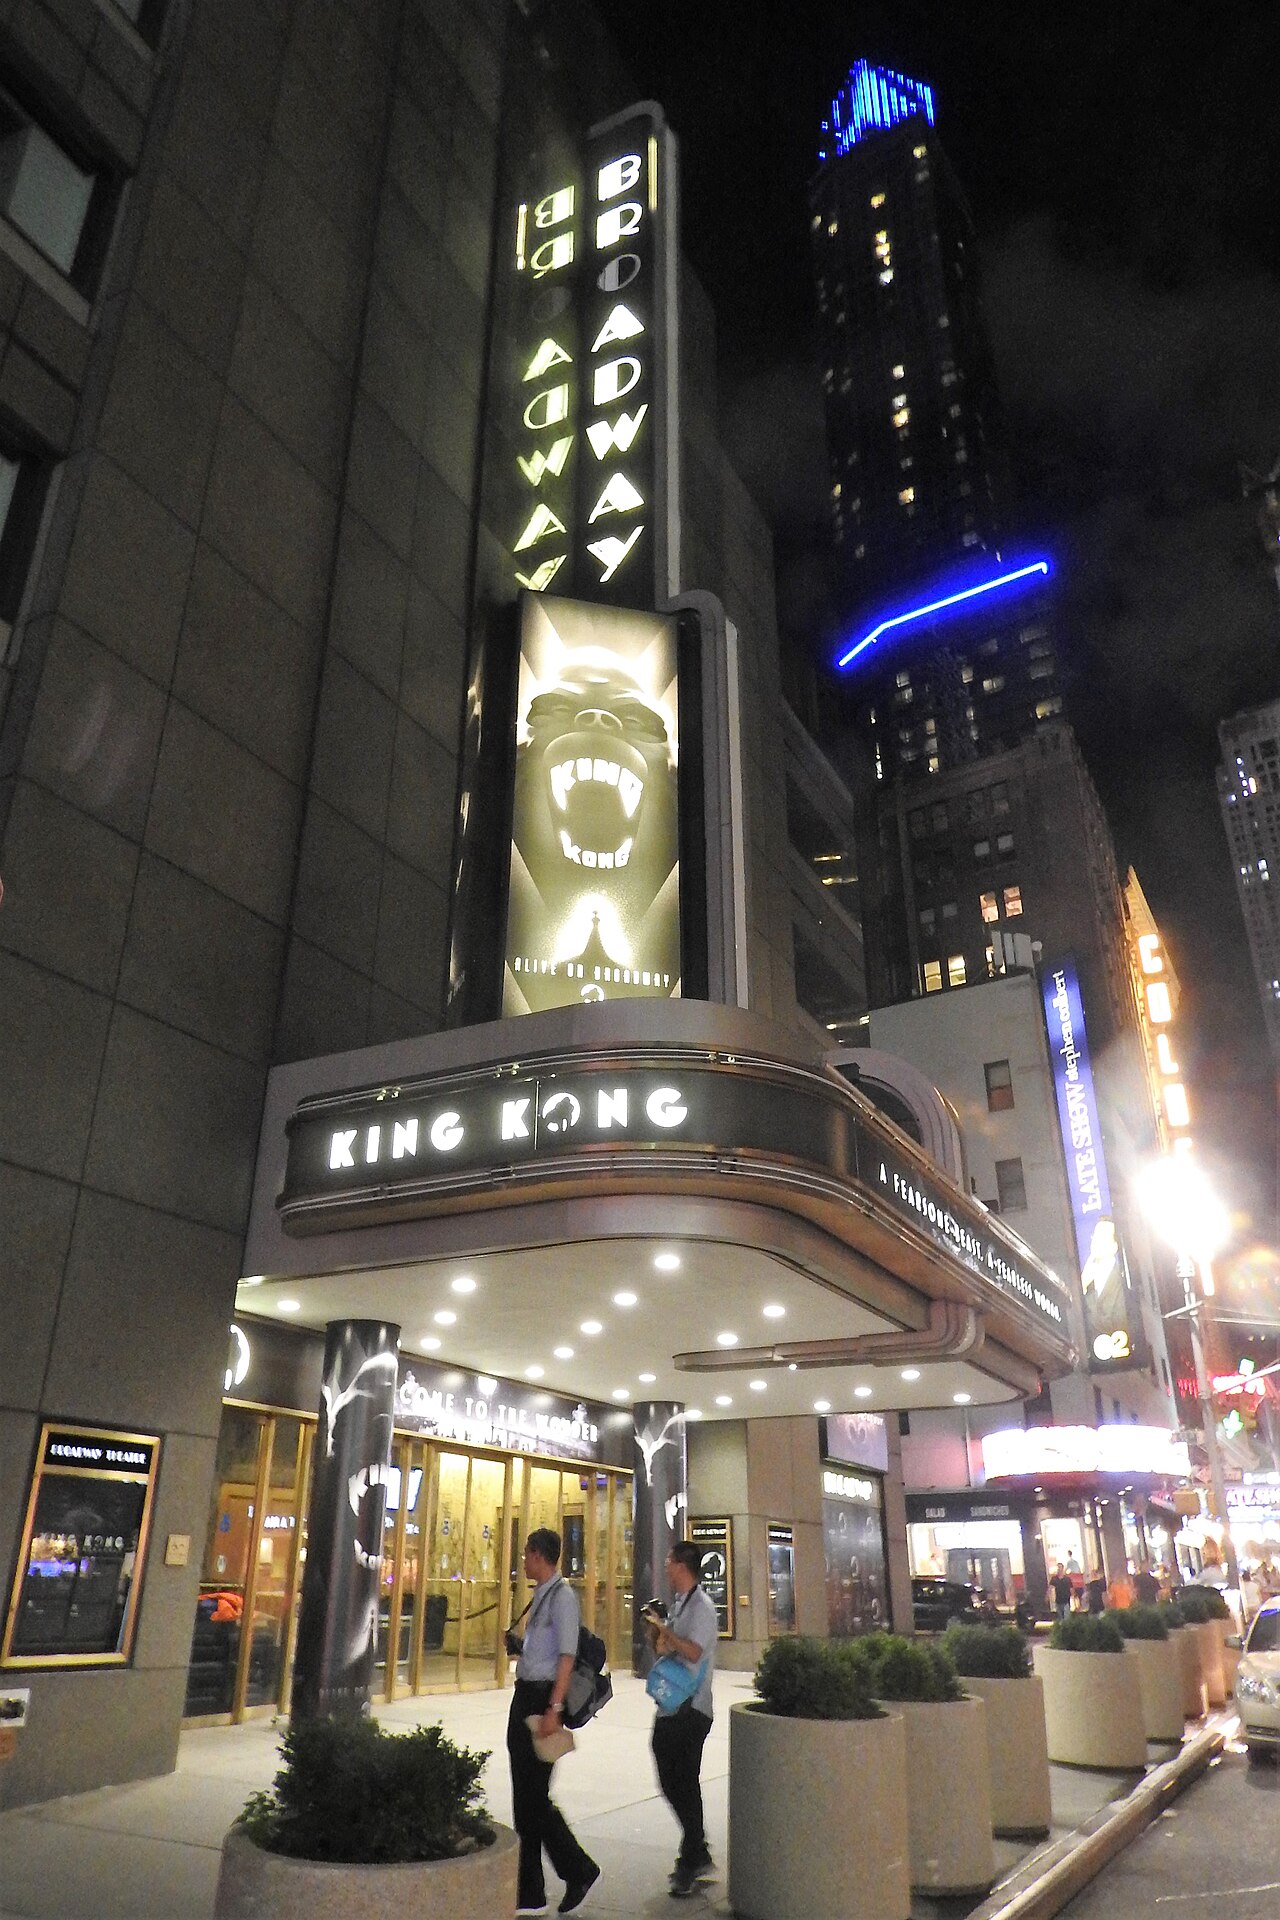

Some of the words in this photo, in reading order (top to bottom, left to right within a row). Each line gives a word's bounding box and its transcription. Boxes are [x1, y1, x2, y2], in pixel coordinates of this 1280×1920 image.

[586, 154, 649, 583] BROADWAY
[514, 956, 557, 976] ALIVE
[328, 1110, 465, 1170] KING
[501, 1087, 688, 1140] KONG
[1065, 1081, 1093, 1149] SHOW
[879, 1162, 888, 1184] A
[893, 1173, 950, 1235] FEARSOME
[1075, 1147, 1102, 1214] LATE
[399, 1381, 455, 1412] COME
[465, 1397, 488, 1420] TO
[497, 1404, 527, 1425] THE
